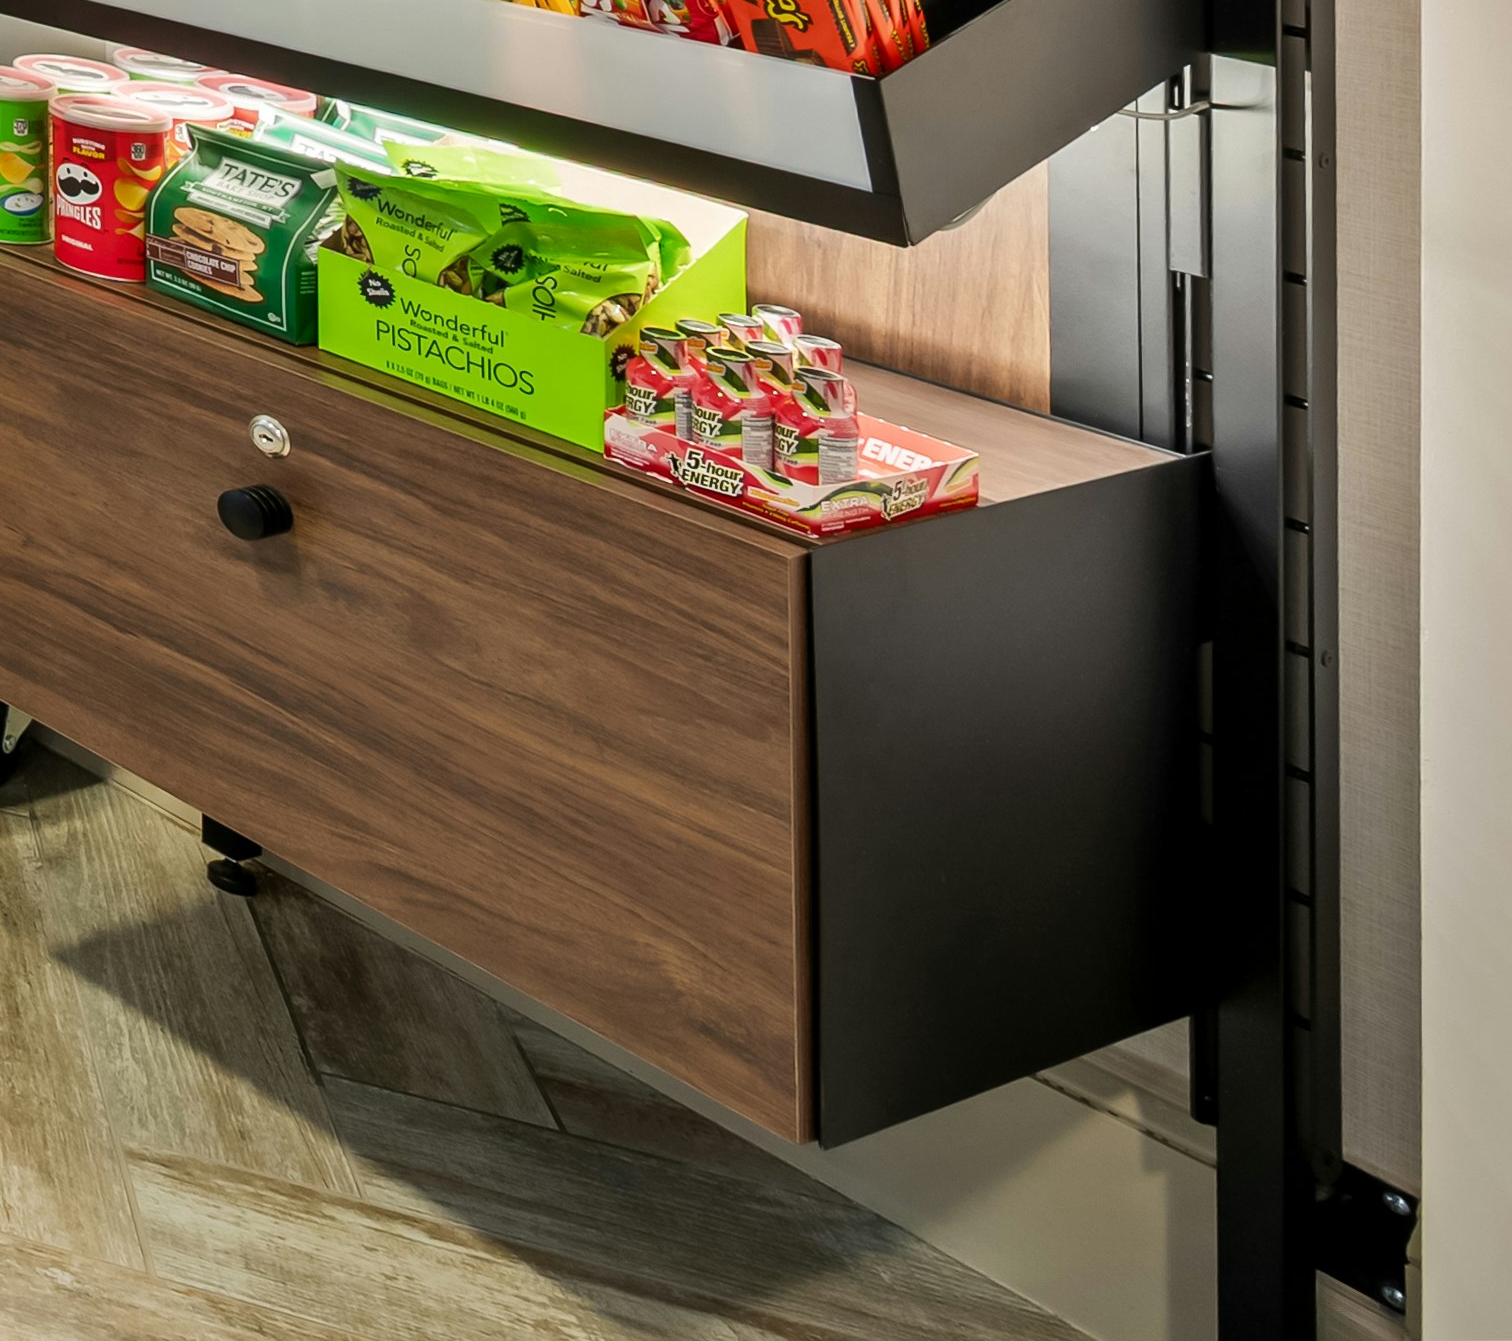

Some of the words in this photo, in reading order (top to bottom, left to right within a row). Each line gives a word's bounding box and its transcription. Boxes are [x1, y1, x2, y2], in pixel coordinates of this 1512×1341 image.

[72, 147, 105, 160] FLAVOR
[216, 180, 245, 194] BAKE
[247, 187, 275, 203] SHOP
[220, 163, 295, 198] TATE'S
[56, 194, 102, 231] PRINGLES
[377, 199, 454, 241] Wonderful
[376, 217, 416, 237] Roasted
[417, 233, 424, 242] &
[187, 250, 220, 269] CHOCOLATE
[220, 260, 236, 273] CHIP
[187, 261, 213, 276] COOKIES
[564, 265, 602, 283] Salted
[368, 278, 382, 287] No
[400, 297, 505, 348] Wonderful
[410, 319, 448, 339] Roasted
[452, 334, 459, 342] &
[463, 337, 493, 354] Salted
[376, 319, 534, 395] PISTACHIOS
[432, 377, 448, 389] BAGS
[454, 384, 465, 396] NET
[467, 389, 476, 400] WT
[481, 395, 489, 405] LB
[627, 386, 654, 400] hour
[626, 401, 654, 415] RGY
[862, 436, 944, 470] ENER
[686, 450, 742, 482] 5-hour
[681, 471, 743, 496] ENERGY
[821, 496, 870, 512] EXTRA
